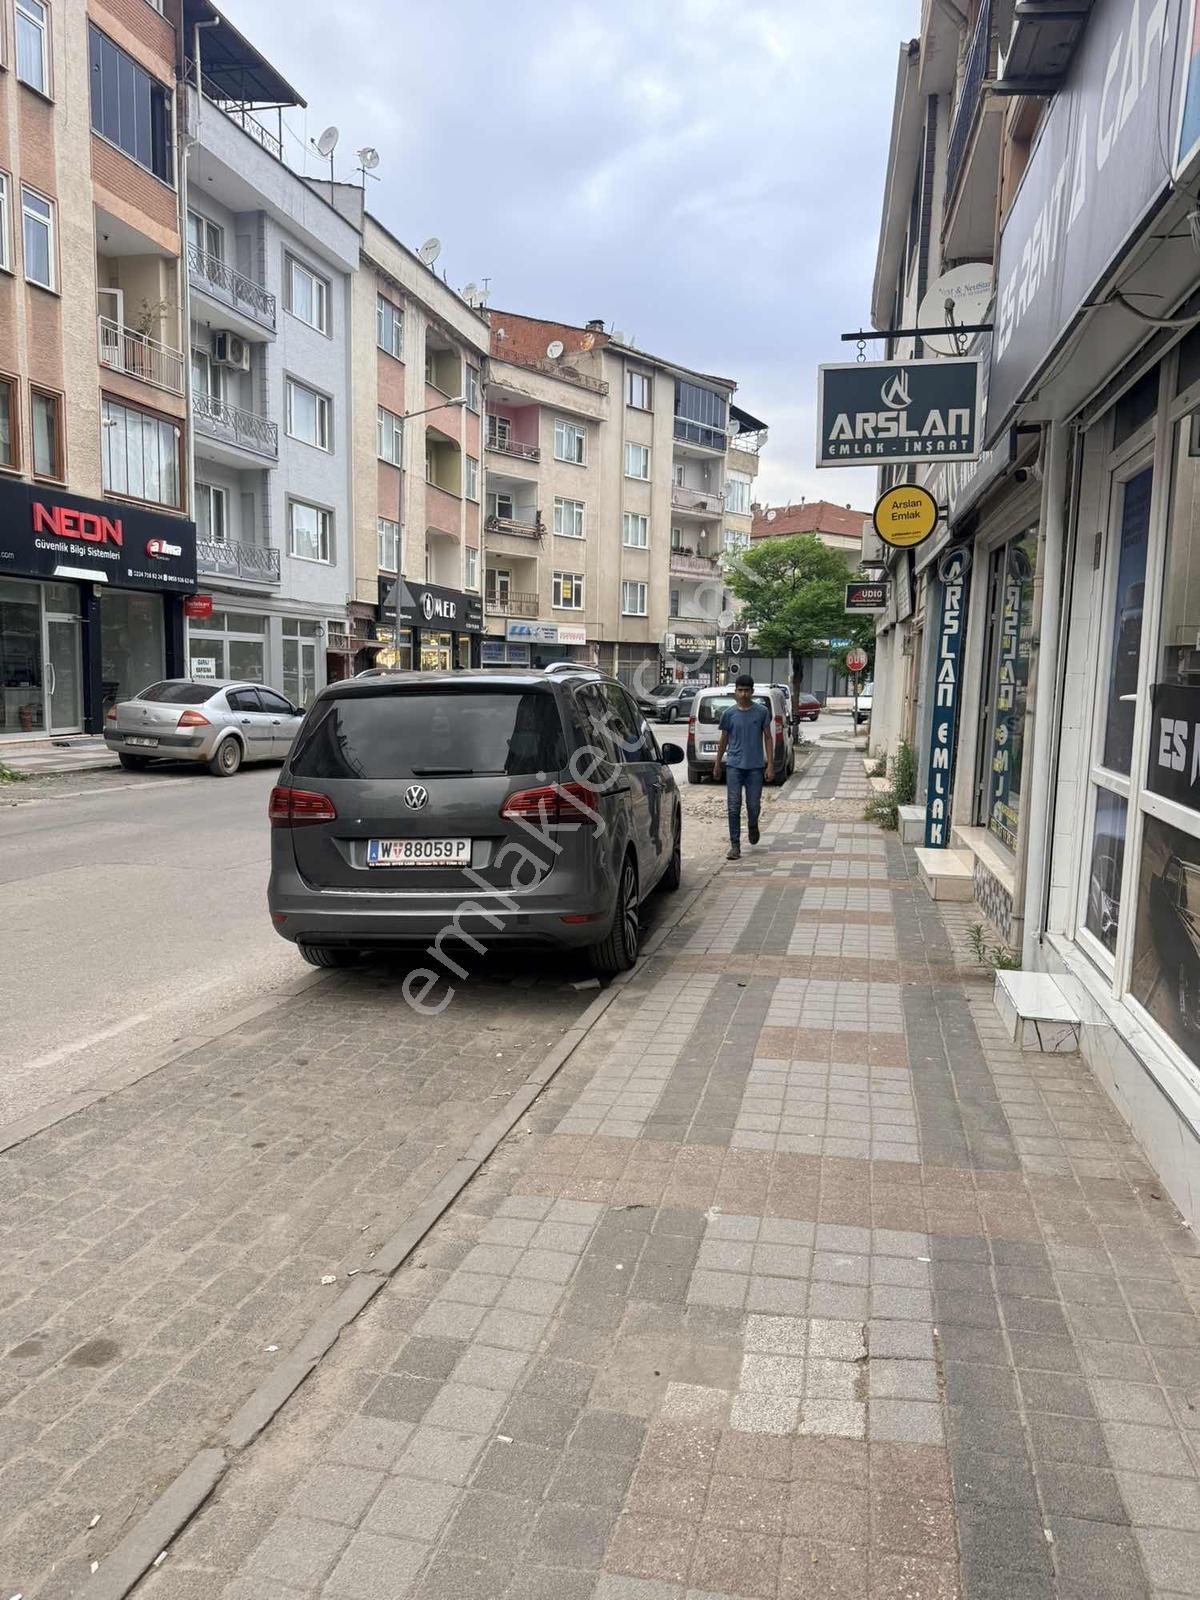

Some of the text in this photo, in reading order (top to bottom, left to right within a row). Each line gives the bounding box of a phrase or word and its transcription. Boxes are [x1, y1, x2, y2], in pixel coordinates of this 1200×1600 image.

[1016, 155, 1070, 329] RENT
[829, 408, 970, 440] ARSLAN
[829, 443, 884, 456] EMLAK
[905, 439, 968, 455] İNŞAAT
[891, 511, 921, 521] Emlak
[892, 499, 922, 510] Arslan
[32, 502, 123, 546] NEON
[35, 538, 121, 561] Güvenlik Bilgi Sistemleri
[931, 560, 963, 845] ARSLAN EMLAK
[1158, 717, 1188, 772] ES
[381, 842, 392, 858] W
[404, 842, 453, 858] 88059
[456, 841, 465, 857] P
